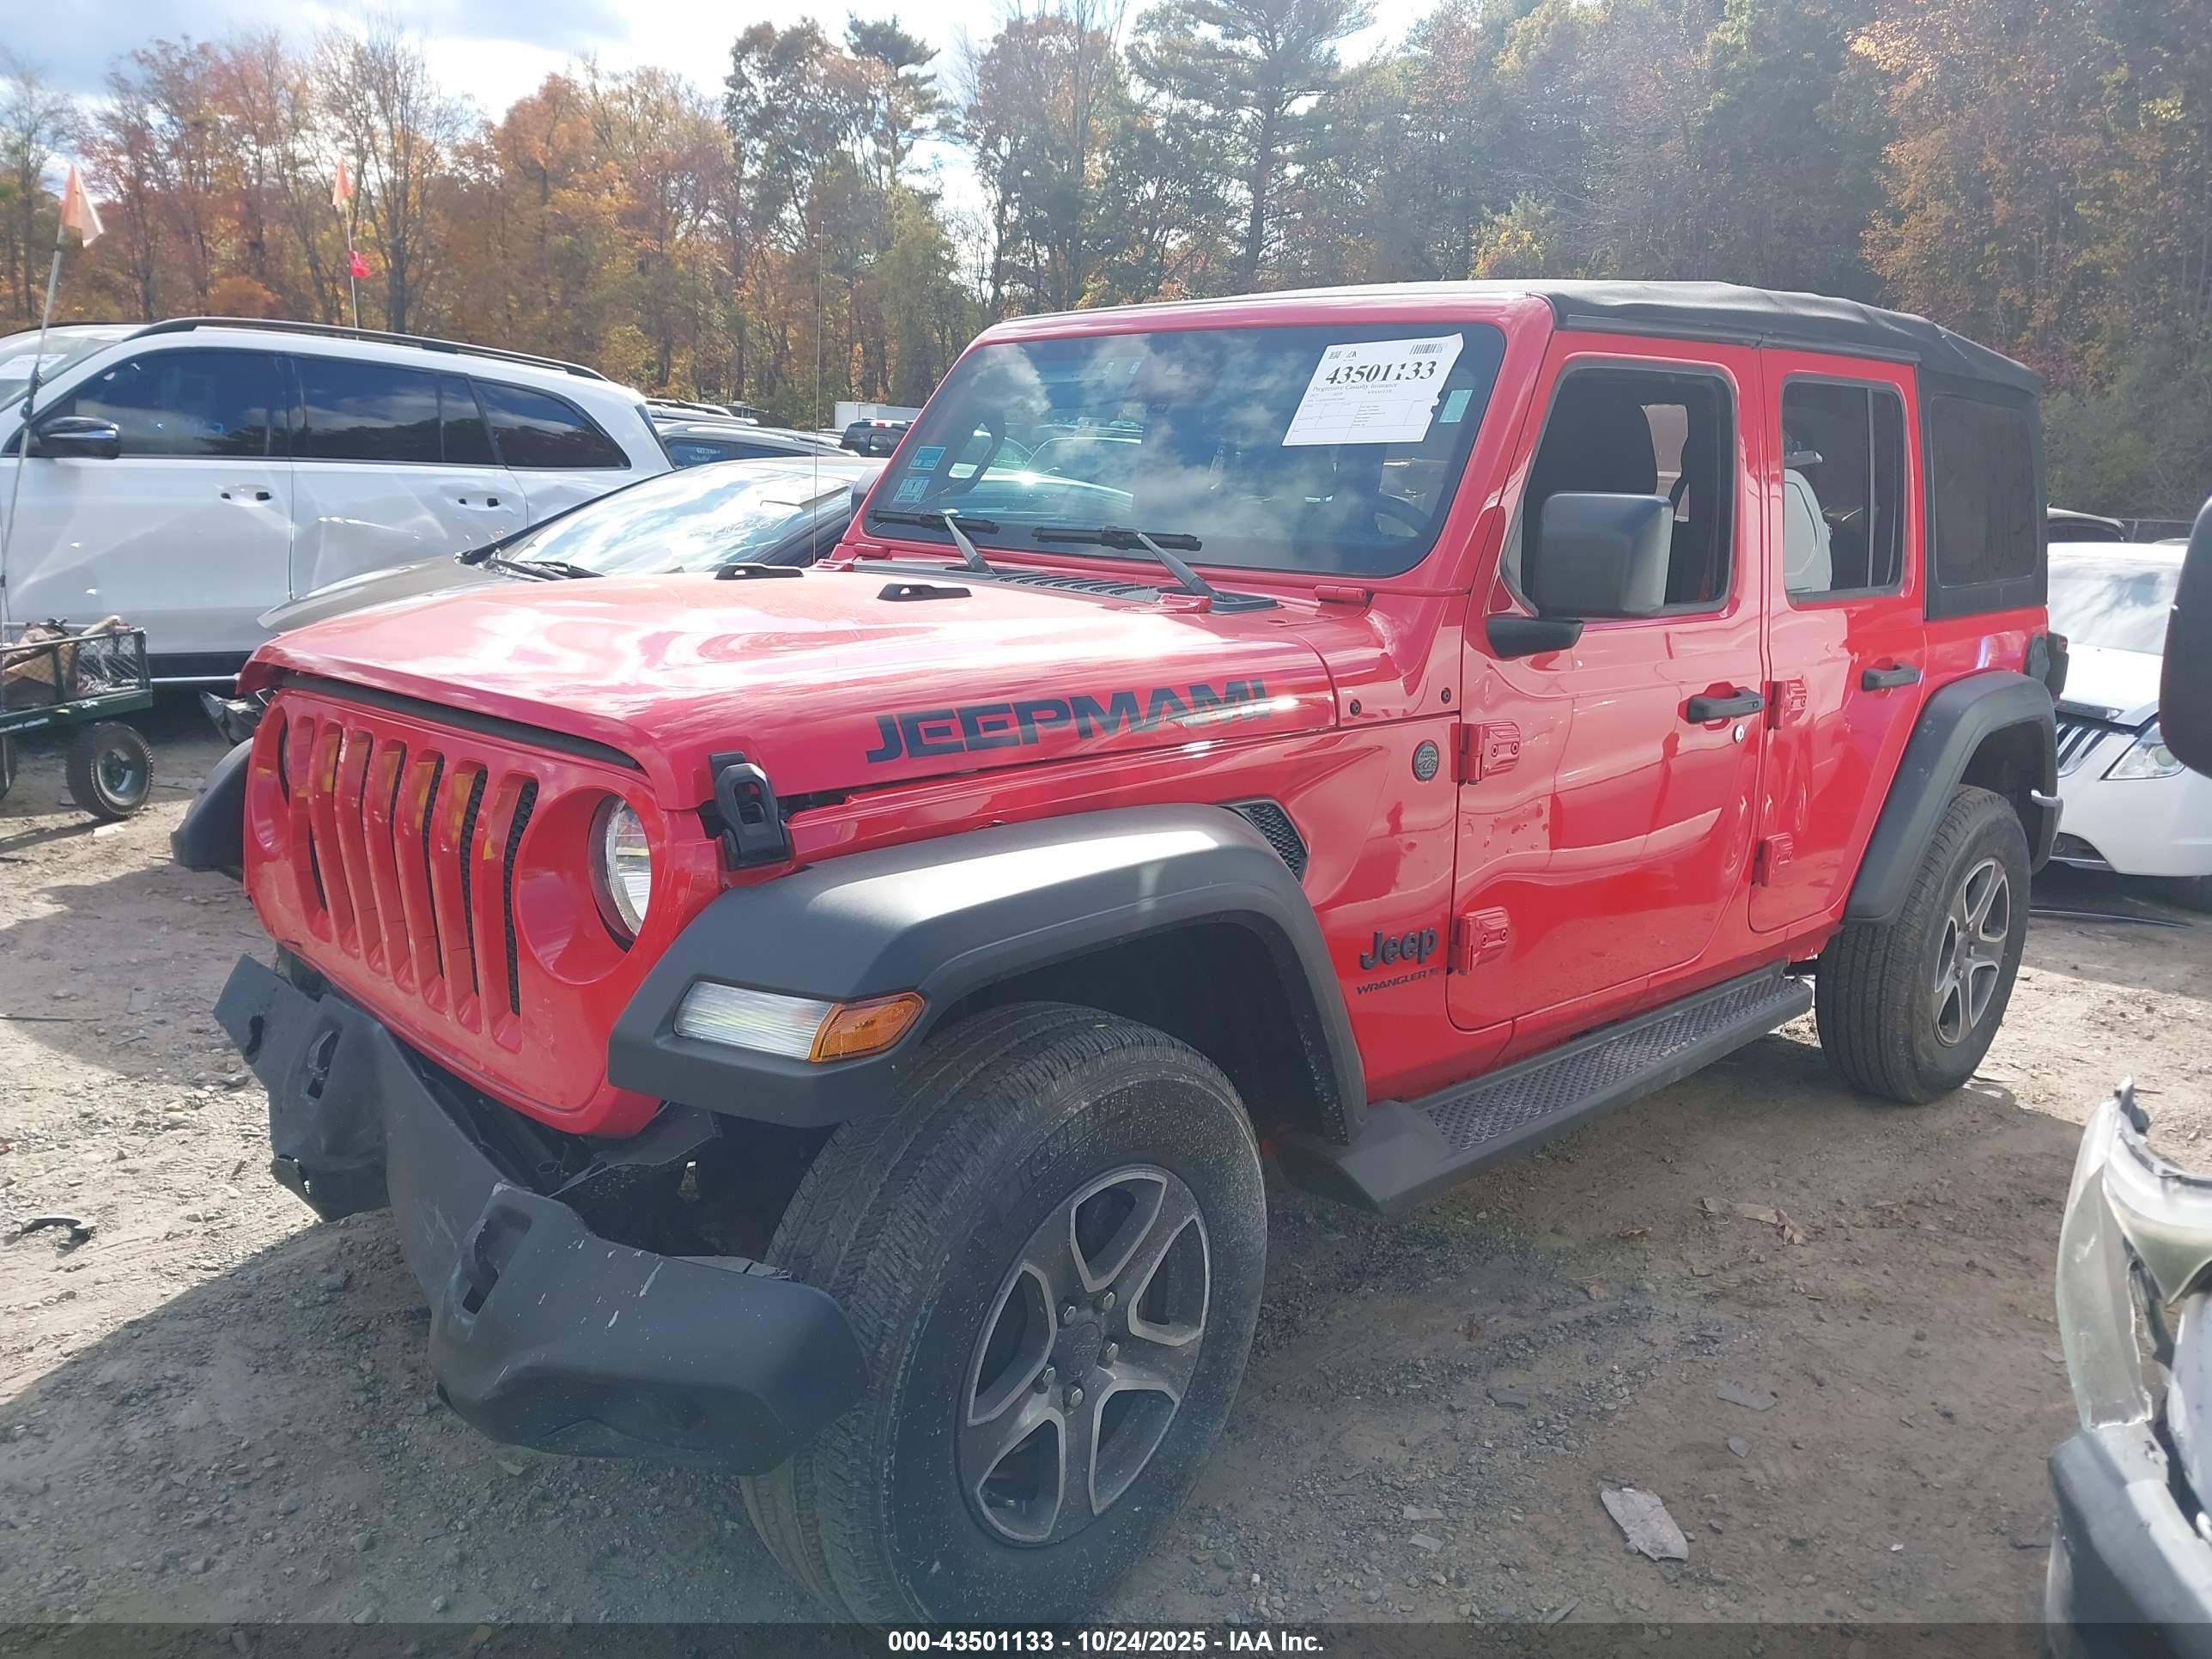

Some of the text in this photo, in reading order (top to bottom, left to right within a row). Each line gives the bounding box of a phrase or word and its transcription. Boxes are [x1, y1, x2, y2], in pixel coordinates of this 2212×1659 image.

[1325, 361, 1437, 385] 43501133
[1359, 927, 1437, 970] Jeep
[1357, 969, 1427, 995] WRANGLER
